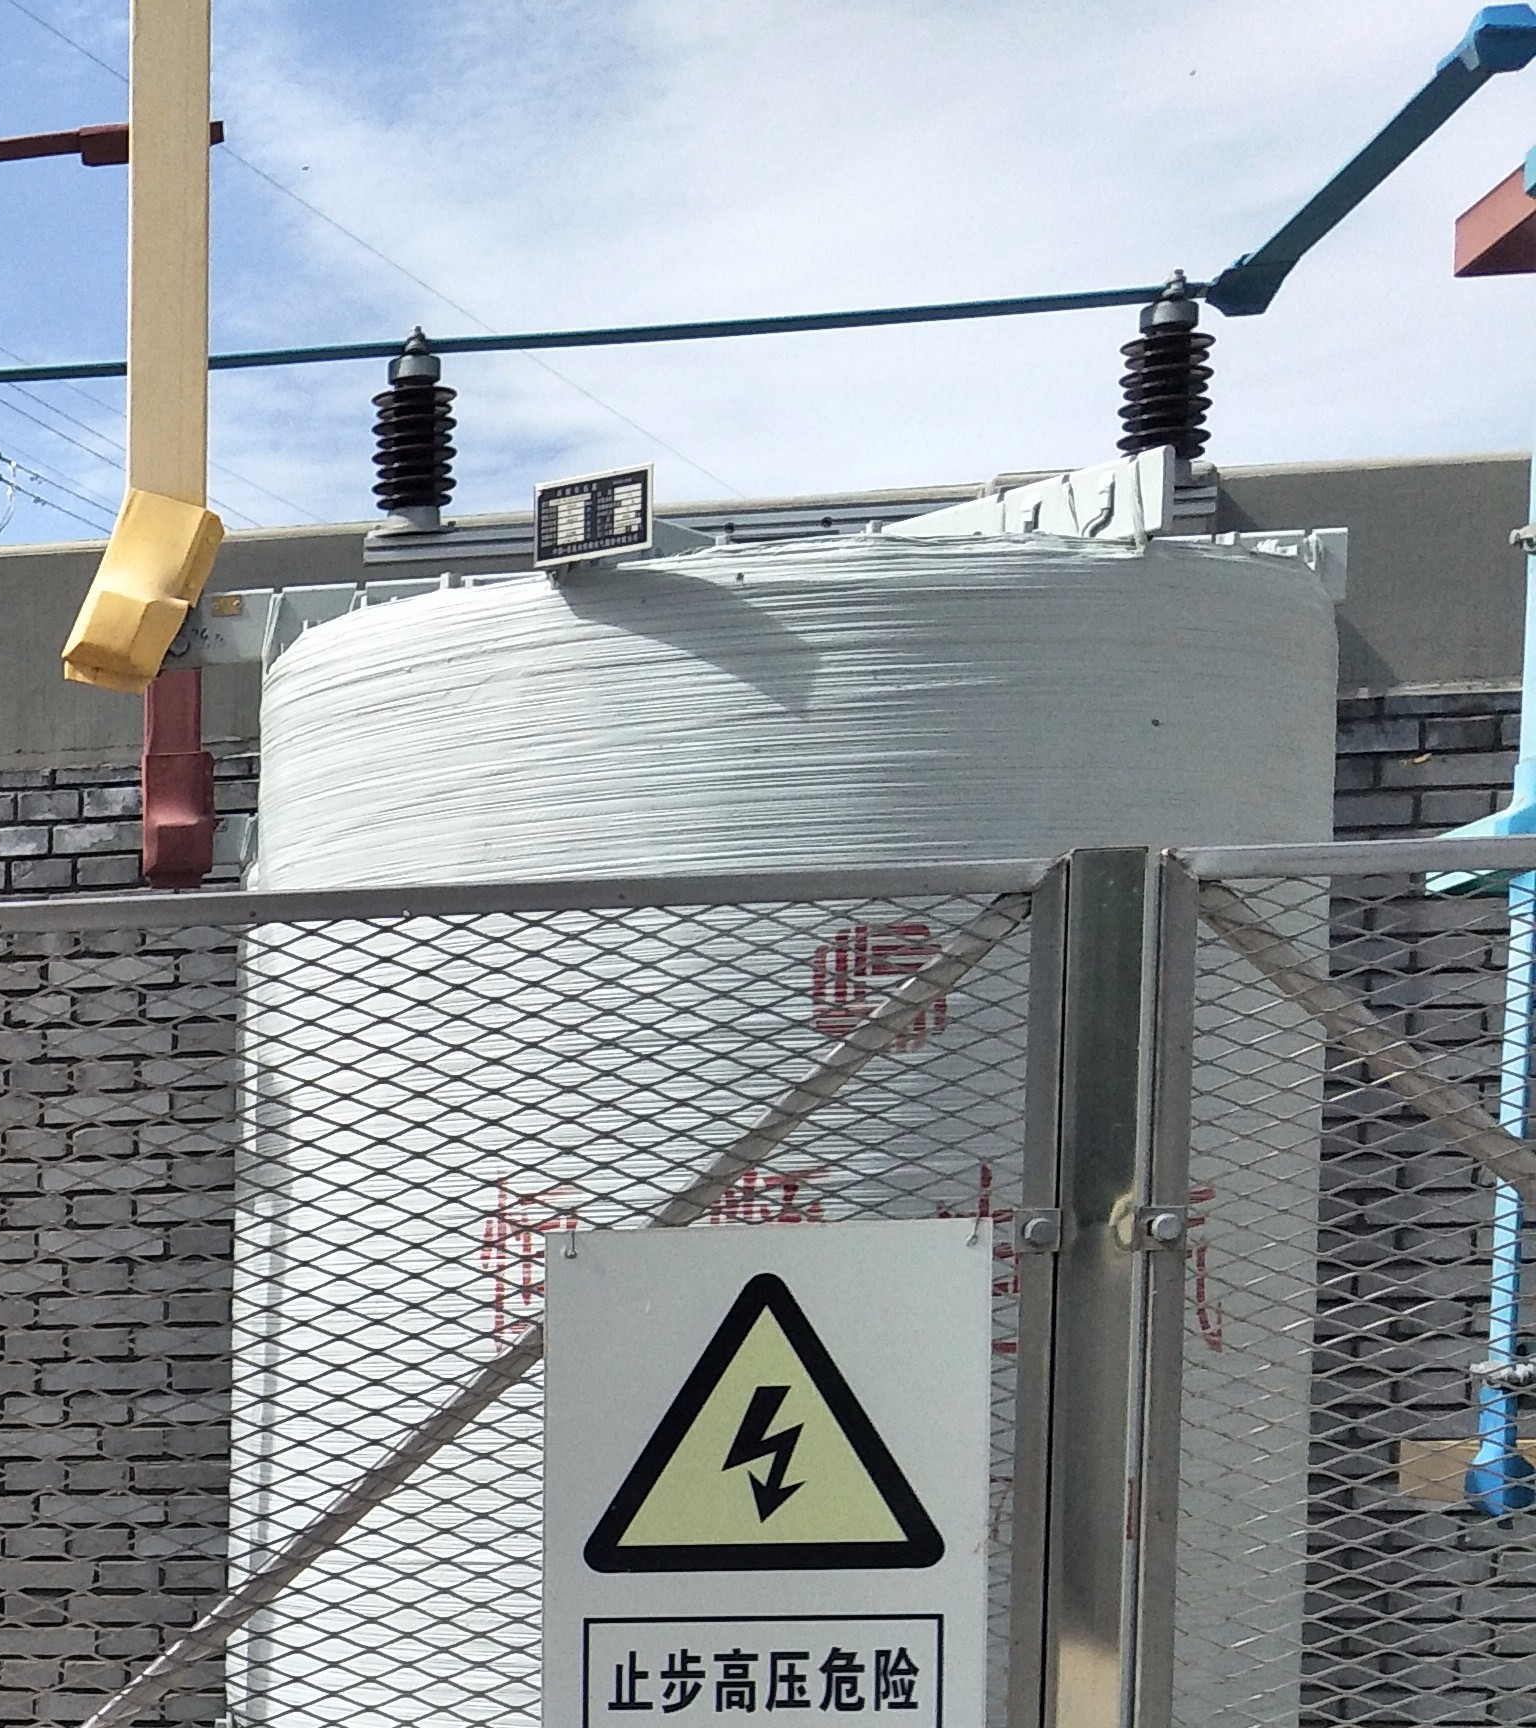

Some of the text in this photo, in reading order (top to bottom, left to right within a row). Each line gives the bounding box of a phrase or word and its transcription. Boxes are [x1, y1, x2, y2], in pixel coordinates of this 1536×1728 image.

[607, 1646, 920, 1714] 止步高压危险
